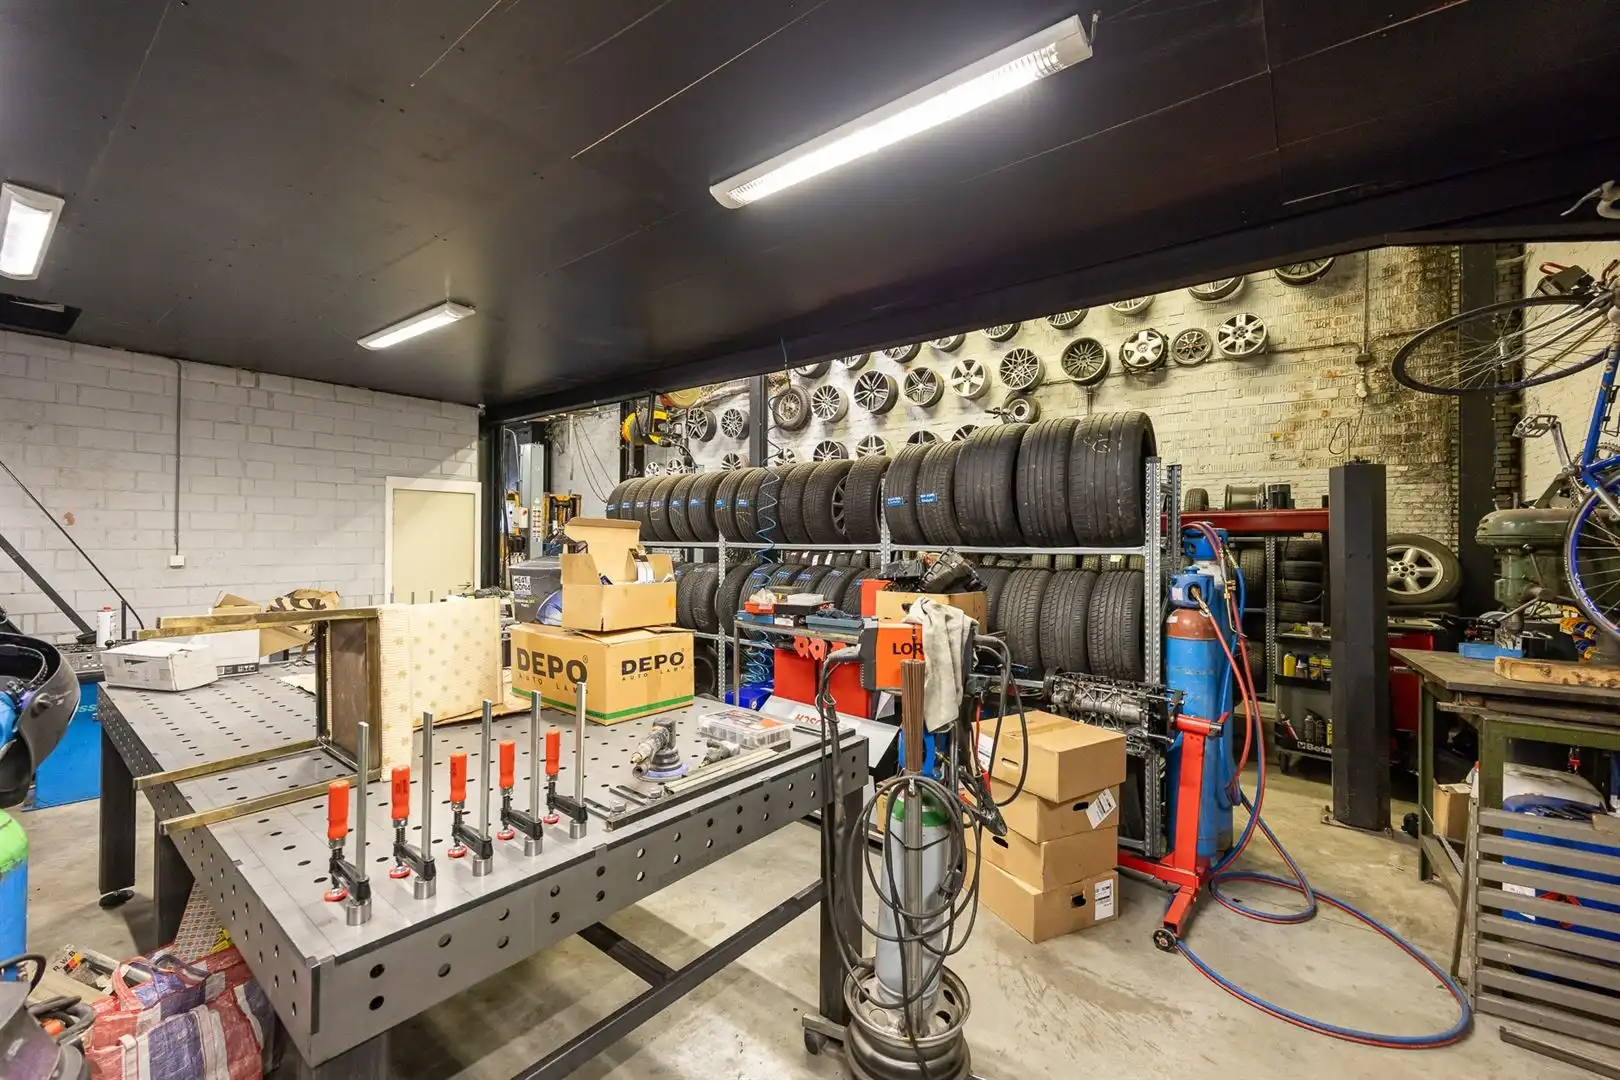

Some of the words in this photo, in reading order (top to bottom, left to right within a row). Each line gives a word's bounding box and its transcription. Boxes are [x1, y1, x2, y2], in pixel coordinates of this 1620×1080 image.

[892, 642, 924, 656] LOR
[516, 647, 588, 685] DEPO
[621, 651, 684, 676] DEPO
[518, 671, 543, 685] AUTO
[622, 673, 648, 681] AUTO
[1306, 743, 1332, 754] Beta
